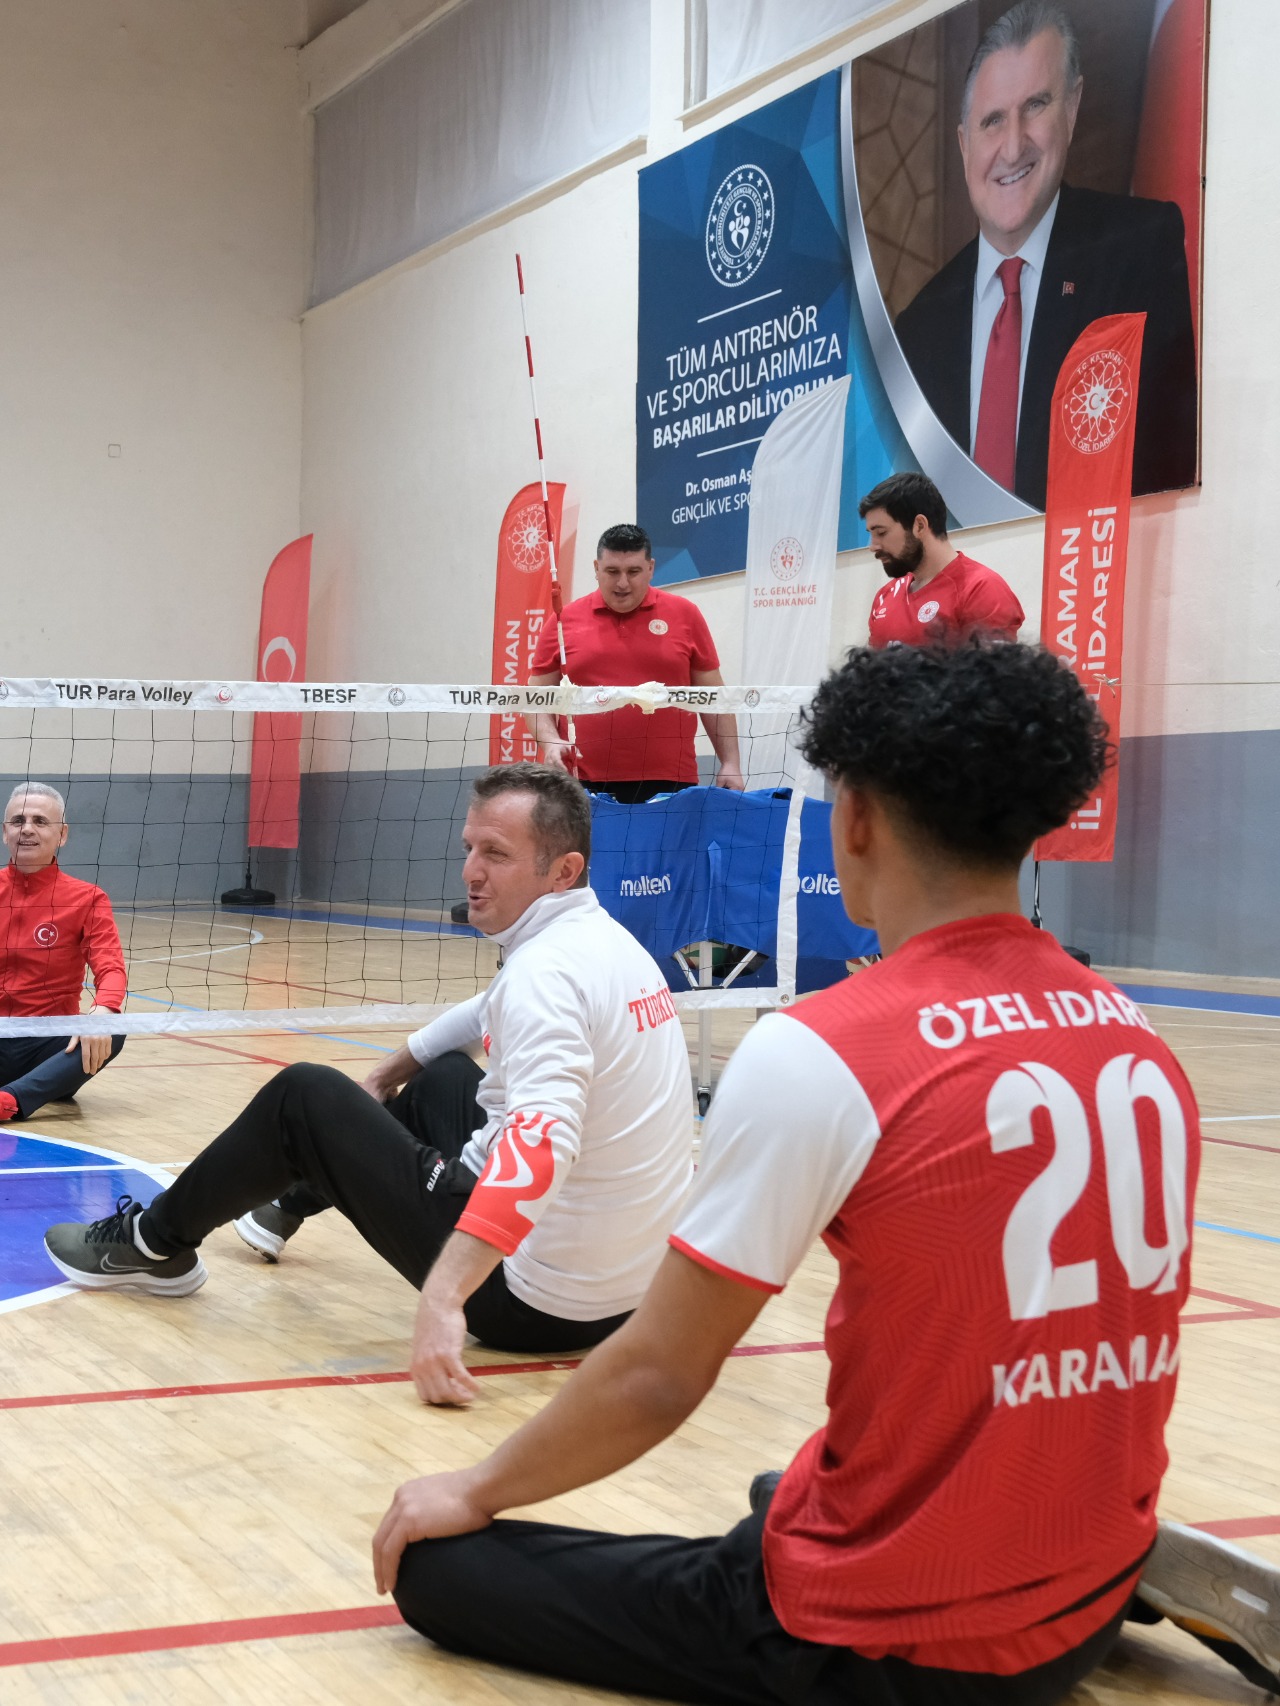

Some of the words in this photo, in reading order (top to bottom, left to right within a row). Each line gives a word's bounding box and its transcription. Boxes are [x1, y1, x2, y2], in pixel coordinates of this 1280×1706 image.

[666, 344, 707, 381] TÜM
[710, 305, 818, 369] ANTRENÖR
[646, 389, 669, 419] VE
[672, 333, 842, 413] SPORCULARIMIZA
[653, 406, 736, 448] BAŞARILAR
[685, 480, 701, 497] Dr.
[701, 473, 737, 491] Osman
[671, 497, 717, 525] GENÇLİK
[717, 494, 732, 514] VE
[753, 600, 774, 608] SPOR
[1081, 505, 1118, 671] İDARESİ
[55, 683, 93, 700] TUR
[97, 685, 137, 701] Para
[141, 686, 193, 706] Volley
[300, 688, 357, 704] TBESF
[449, 690, 483, 706] TUR
[486, 691, 521, 706] Para
[525, 691, 562, 706] Voll
[668, 690, 718, 706] TBESF
[501, 620, 521, 762] KARMAN
[1070, 797, 1103, 831] İL
[620, 874, 671, 896] molten
[797, 873, 841, 896] olte
[628, 981, 678, 1032] TÜRKİ
[918, 992, 1047, 1049] ÖZEL
[1046, 989, 1157, 1036] İDAR
[986, 1053, 1188, 1321] 20
